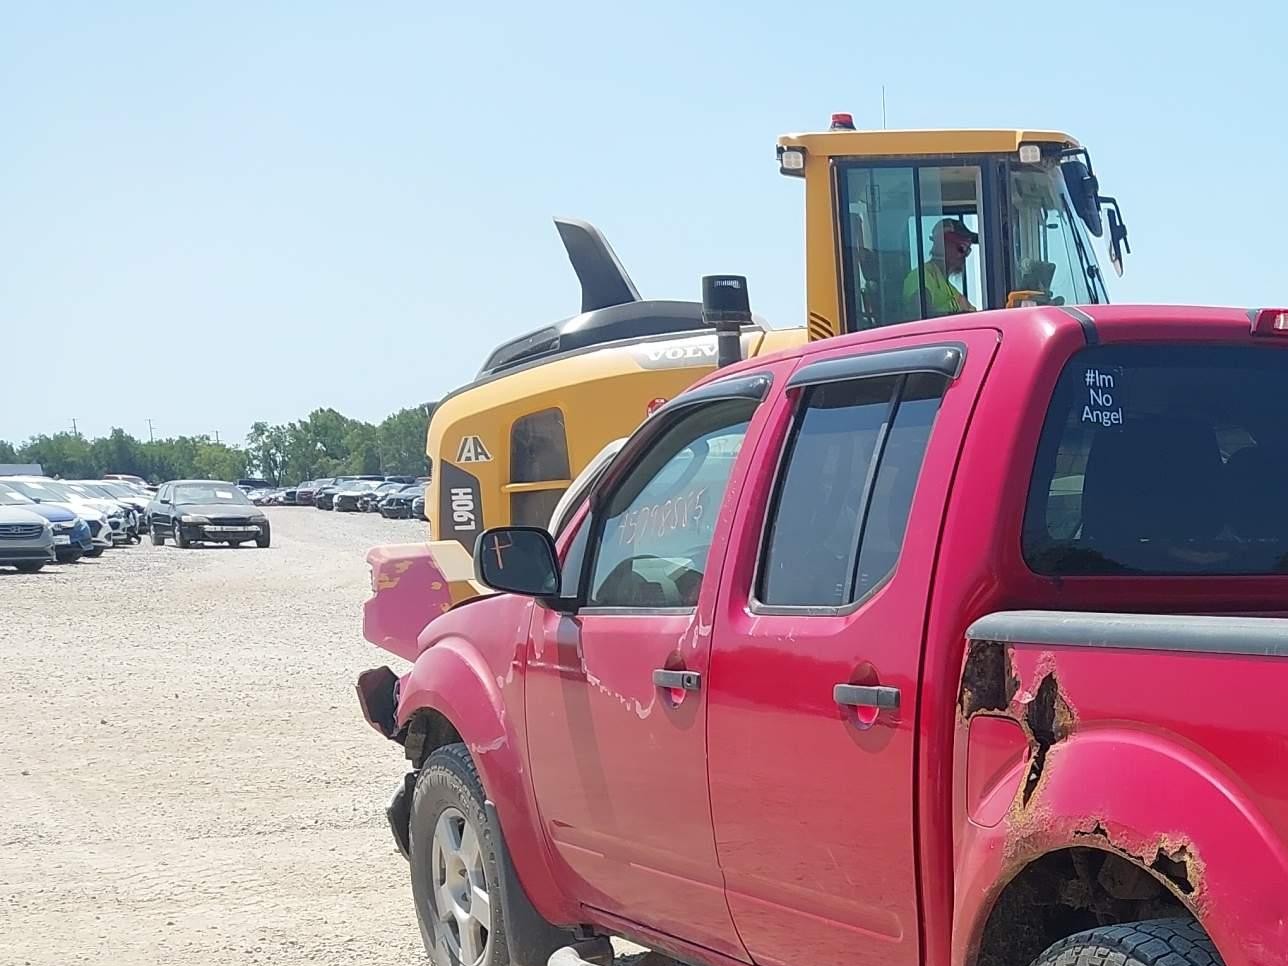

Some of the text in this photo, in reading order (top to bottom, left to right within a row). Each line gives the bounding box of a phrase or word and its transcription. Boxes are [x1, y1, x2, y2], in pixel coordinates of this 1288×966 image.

[647, 343, 719, 361] VOLV
[1085, 369, 1114, 388] #Im
[1090, 388, 1113, 407] No
[1082, 405, 1123, 427] Angel
[450, 487, 476, 531] L90H
